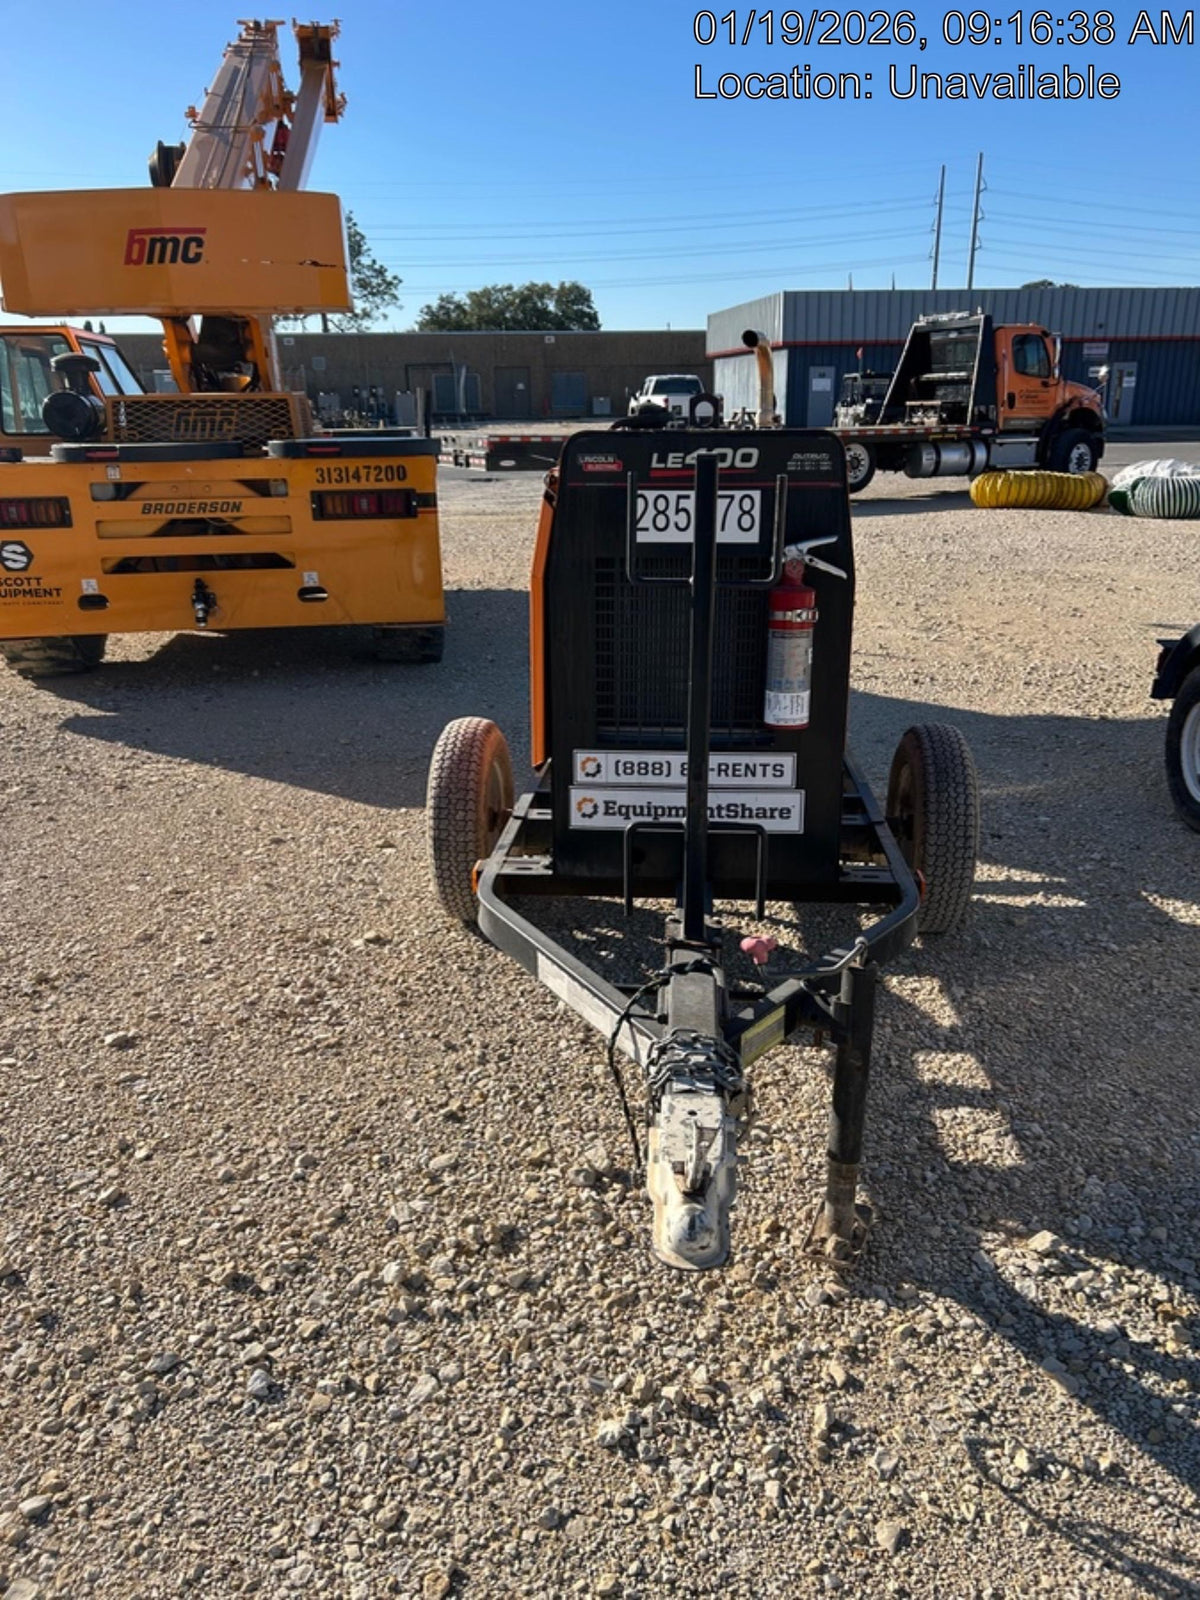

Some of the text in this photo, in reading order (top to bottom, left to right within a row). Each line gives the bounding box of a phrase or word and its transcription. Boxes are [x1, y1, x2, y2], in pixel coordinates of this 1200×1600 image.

[579, 455, 615, 463] LINCOLN
[315, 464, 408, 484] 313147200
[141, 501, 243, 515] BRODERSON
[636, 493, 755, 533] 28578
[0, 587, 63, 598] UIPMENT
[614, 760, 785, 779] (888) 8-RENTS
[602, 799, 792, 820] EquipmtShare
